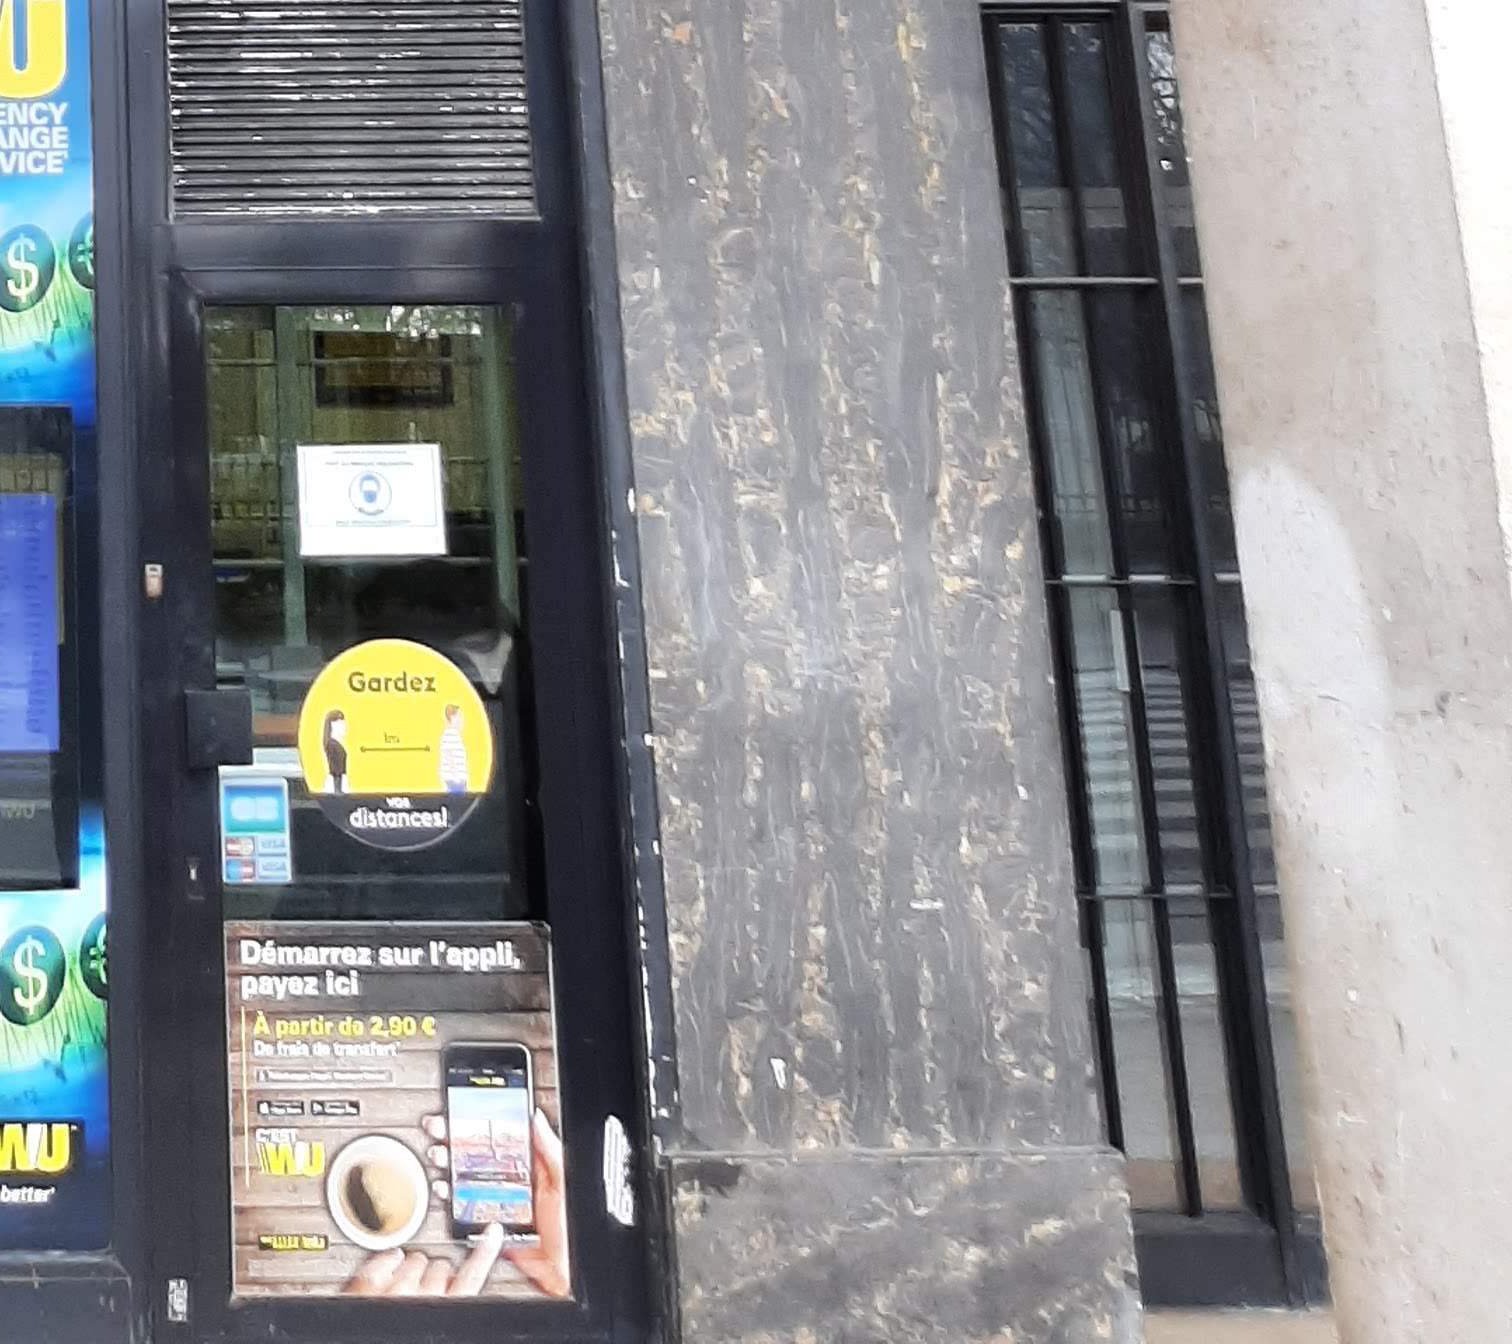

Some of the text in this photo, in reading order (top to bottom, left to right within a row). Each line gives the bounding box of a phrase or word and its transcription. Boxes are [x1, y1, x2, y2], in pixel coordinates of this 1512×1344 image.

[7, 233, 39, 304] $
[348, 671, 436, 693] Gardez
[349, 806, 448, 829] distances!
[240, 940, 372, 966] Démarrez
[378, 946, 424, 966] sur
[13, 935, 48, 1015] $
[241, 970, 360, 1000] payez ici
[275, 1015, 333, 1039] partir
[338, 1016, 364, 1036] de
[265, 1140, 326, 1176] WU
